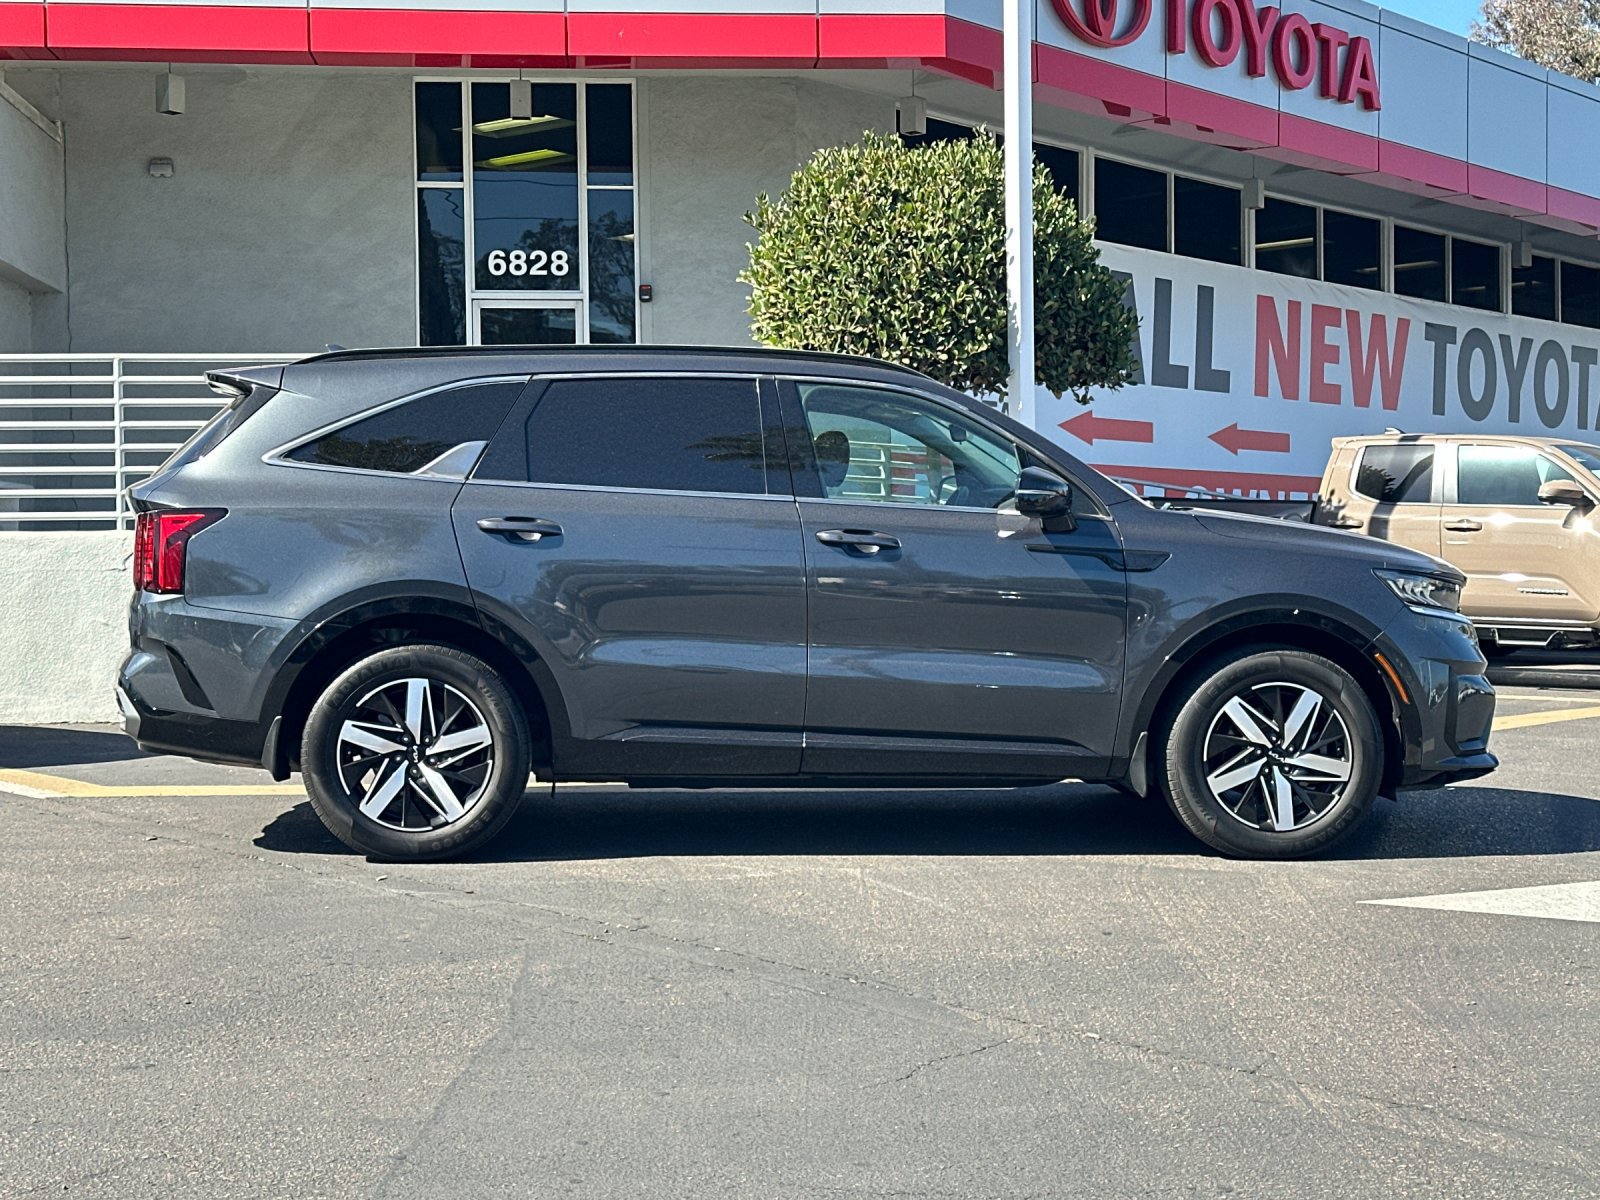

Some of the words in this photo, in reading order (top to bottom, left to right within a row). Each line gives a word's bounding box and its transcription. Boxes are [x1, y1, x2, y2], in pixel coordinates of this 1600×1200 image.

[487, 249, 570, 276] 6828
[1254, 294, 1411, 411] NEW
[1424, 321, 1600, 431] TOYOT
